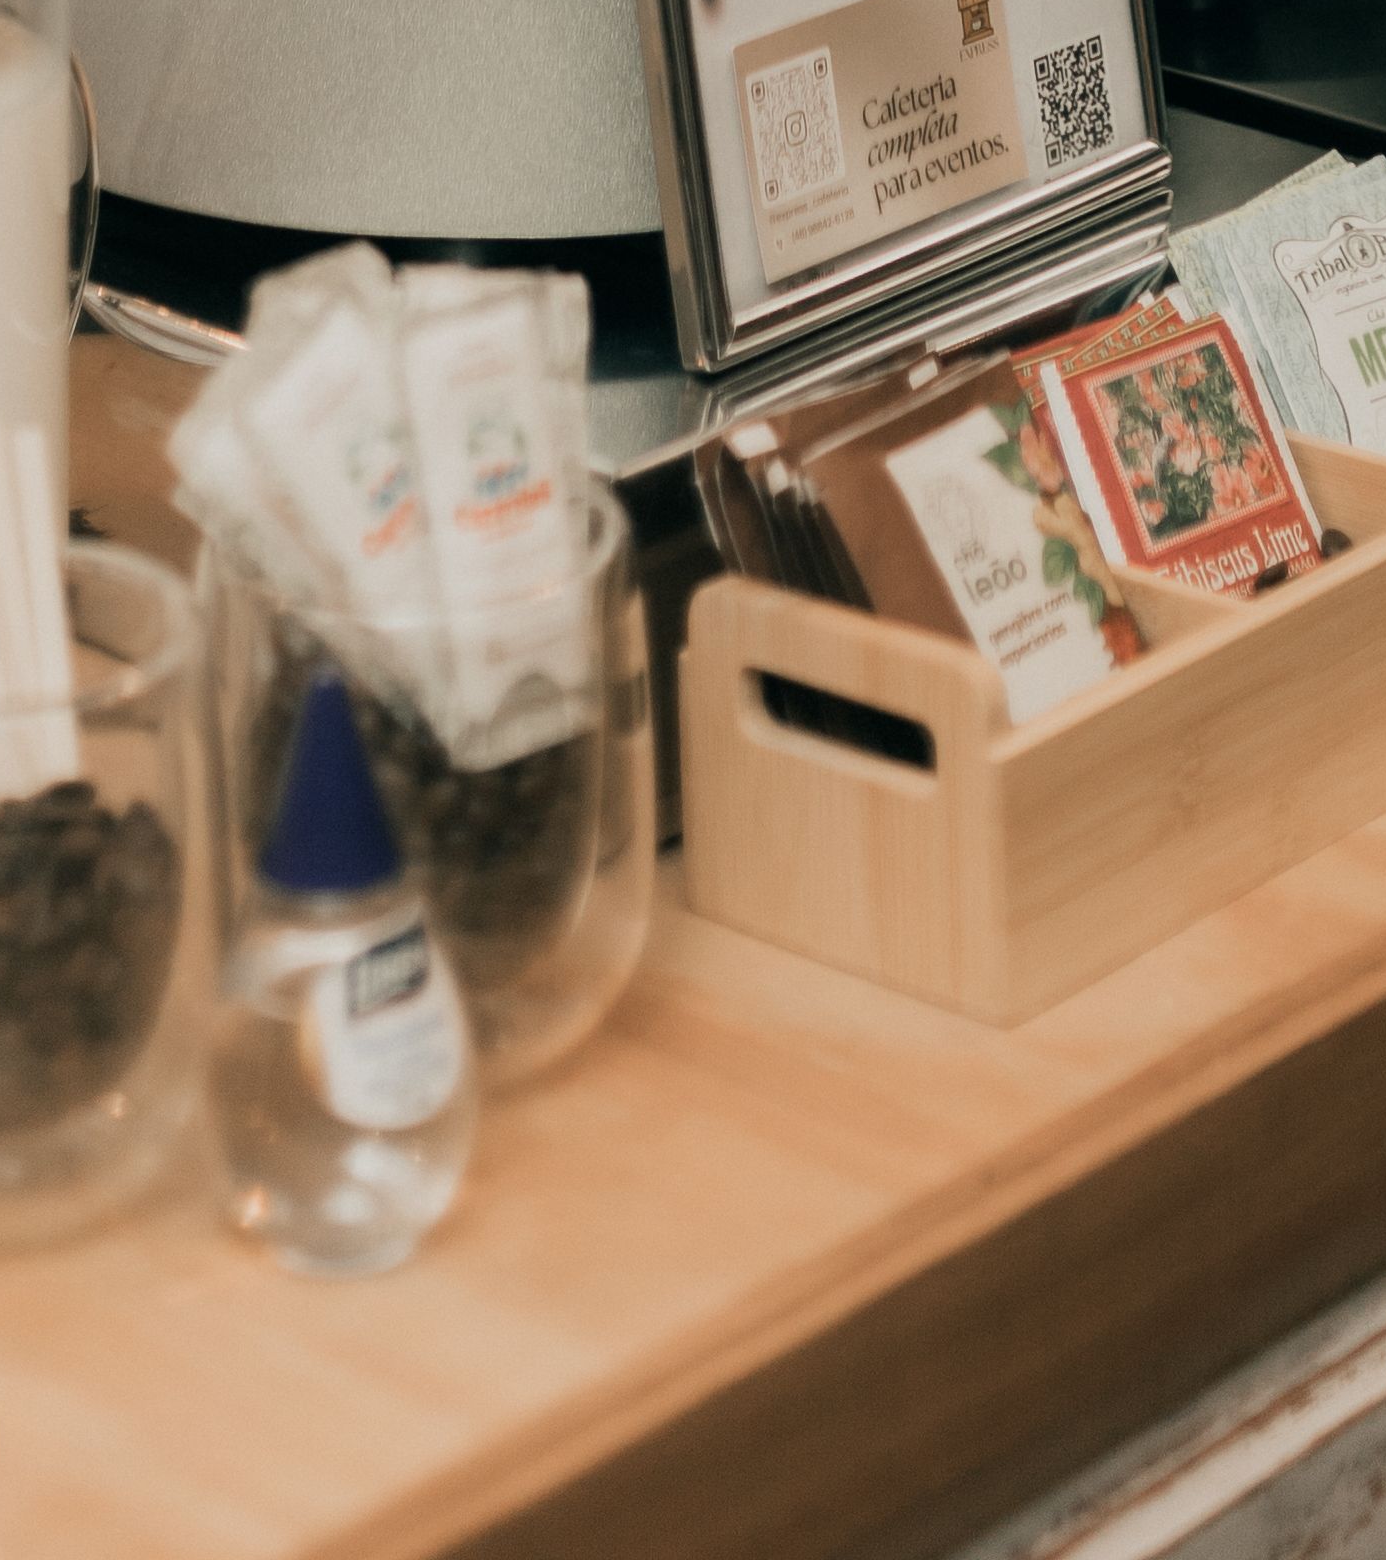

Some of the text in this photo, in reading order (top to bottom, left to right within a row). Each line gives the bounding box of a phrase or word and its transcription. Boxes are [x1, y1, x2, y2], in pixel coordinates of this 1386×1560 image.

[861, 73, 957, 131] Cafeteria
[866, 110, 959, 169] completa
[873, 133, 1010, 215] para eventos.
[1293, 246, 1353, 296] Tribal
[1252, 522, 1310, 569] Lime
